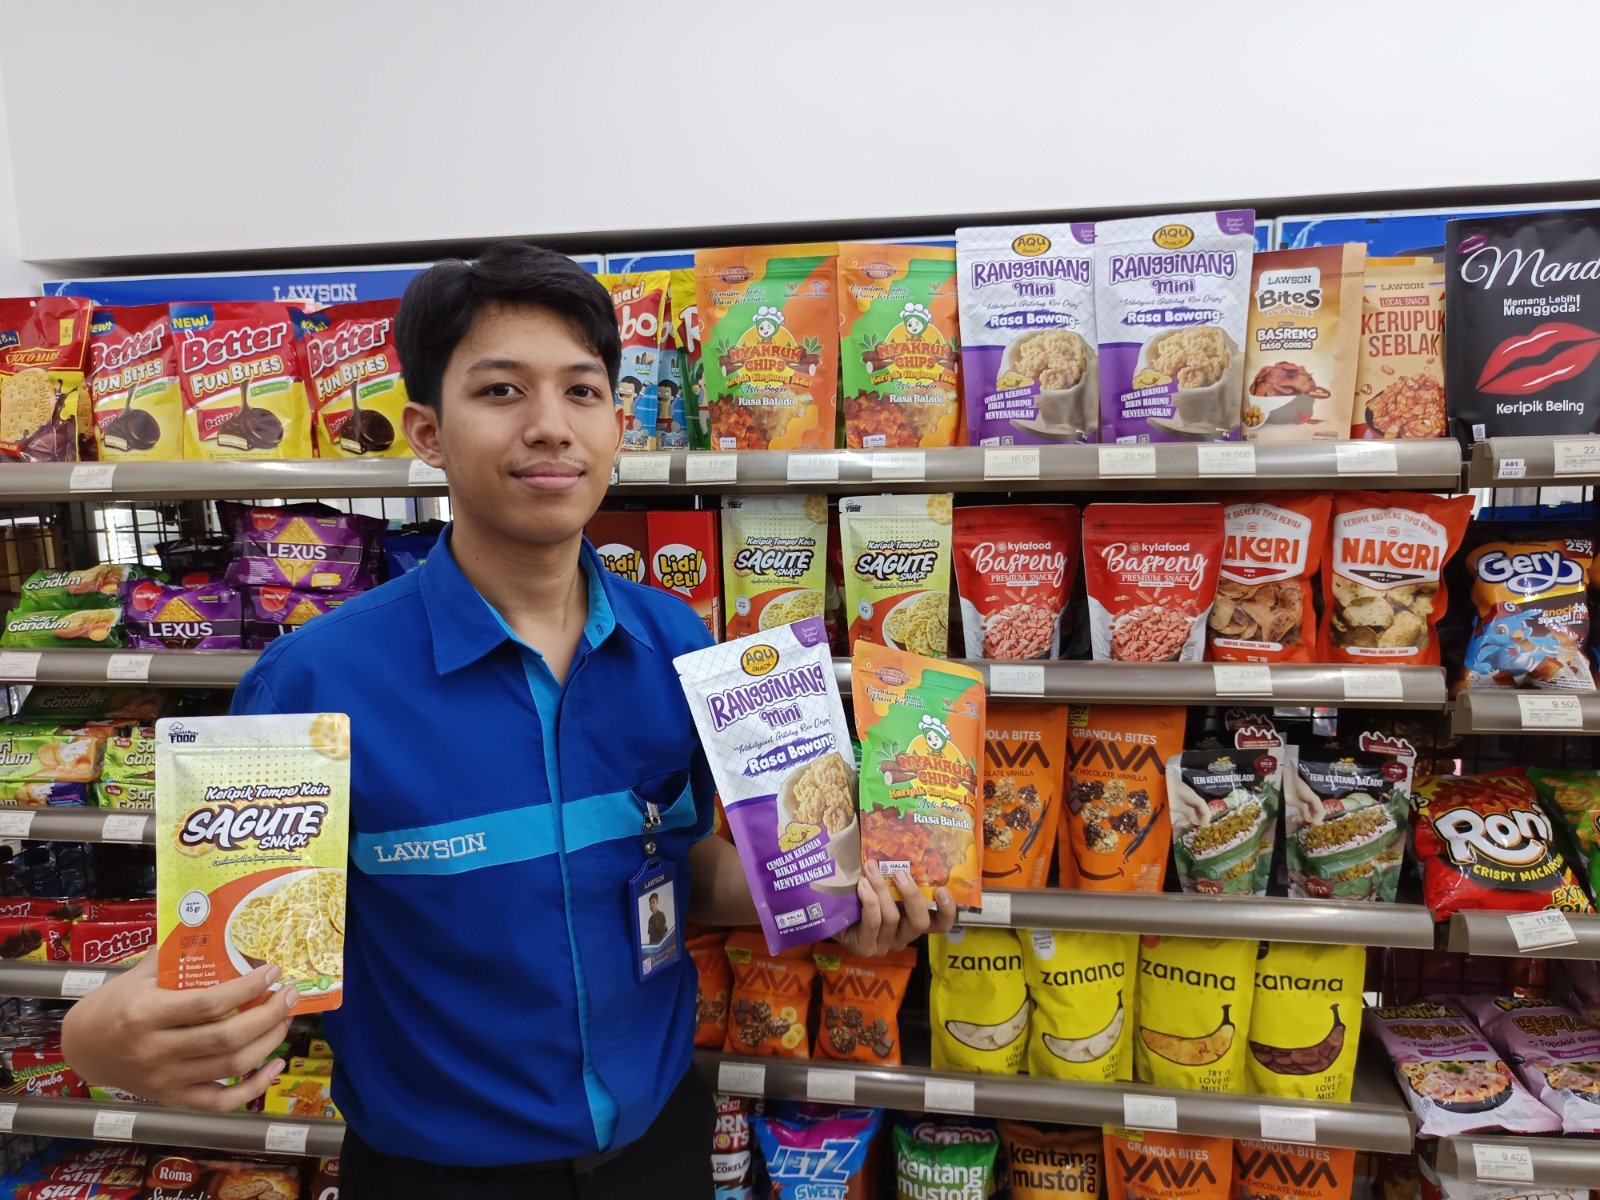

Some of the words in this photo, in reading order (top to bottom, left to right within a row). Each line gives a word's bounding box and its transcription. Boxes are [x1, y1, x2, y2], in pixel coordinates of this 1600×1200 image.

[1159, 228, 1188, 239] AQU
[1267, 274, 1312, 285] LAWSON
[1380, 281, 1425, 291] LAWSON
[273, 284, 357, 303] LAWSON
[1381, 297, 1403, 307] LOCAL
[1404, 296, 1429, 306] SNACK
[1503, 297, 1546, 310] Memang
[173, 314, 209, 330] NEW!
[1127, 311, 1162, 325] Rasa
[1165, 308, 1222, 325] Bawang
[1257, 327, 1318, 342] BASRENG
[183, 321, 287, 373] Better
[308, 318, 391, 378] Better
[730, 341, 802, 362] NYAKRUK
[879, 342, 949, 359] NYAKRUK
[1260, 341, 1282, 352] BASO
[1283, 341, 1313, 351] GORENG
[1368, 334, 1438, 357] SEBLAK
[743, 358, 786, 372] CHIPS
[894, 356, 935, 369] CHIPS
[738, 396, 759, 407] Rasa
[760, 396, 795, 407] Balado
[1496, 402, 1542, 415] Keripik
[1545, 401, 1585, 416] Beling
[266, 541, 327, 560] LEXUS
[1008, 541, 1052, 554] kylafood
[1141, 542, 1190, 553] kylafood
[736, 548, 813, 576] SAGUTE
[856, 551, 938, 579] SAGUTE
[1121, 573, 1161, 583] PREMIUM
[1163, 573, 1191, 583] SNACK
[1477, 550, 1584, 595] Gery
[7, 618, 70, 634] Gandum
[148, 621, 213, 638] LEXUS
[745, 648, 774, 666] AQU
[752, 663, 771, 673] SNACK
[169, 734, 197, 745] FOOD
[1072, 727, 1122, 742] GRANOLA
[1124, 731, 1158, 746] BITES
[749, 751, 787, 773] Rasa
[789, 734, 837, 763] Bawang
[899, 753, 973, 779] NYAKRUK
[1075, 767, 1116, 780] CHOCOLATE
[1116, 771, 1150, 783] VANILLA
[916, 769, 960, 790] CHIPS
[204, 785, 254, 804] Keripik
[254, 783, 299, 801] Tempe
[299, 782, 331, 798] Koin
[180, 802, 329, 852] SAGUTE
[913, 813, 939, 826] Rasa
[939, 815, 972, 831] Balado
[257, 830, 311, 852] SNACK
[1432, 801, 1553, 866] Roni
[373, 832, 488, 863] LAWSON
[767, 849, 794, 871] CEMILAN
[793, 837, 822, 859] KEKINIAN
[775, 860, 798, 878] BIKIN
[798, 850, 828, 869] HARIMU
[890, 861, 909, 870] HALAL
[773, 864, 833, 892] MENYENANGKAN
[1472, 864, 1516, 883] CRISPY
[185, 905, 194, 914] 45
[194, 906, 201, 915] gr
[82, 926, 153, 964] Better
[947, 953, 1022, 972] zanan
[1040, 961, 1125, 988] zanana
[1142, 959, 1236, 992] zanana
[1199, 1076, 1222, 1086] LOVE
[1208, 1069, 1222, 1078] TRY
[1324, 1074, 1336, 1084] TRY
[26, 1073, 64, 1093] Combo
[1315, 1082, 1336, 1093] LOVE
[1010, 1141, 1098, 1176] kentang
[1127, 1141, 1176, 1160] GRANOLA
[1178, 1149, 1209, 1163] BITES
[159, 1166, 193, 1183] Roma
[898, 1161, 984, 1188] kentang
[1012, 1167, 1098, 1195] mustofa
[1132, 1182, 1173, 1198] CHOCOLATE
[1174, 1187, 1202, 1198] VANILLA
